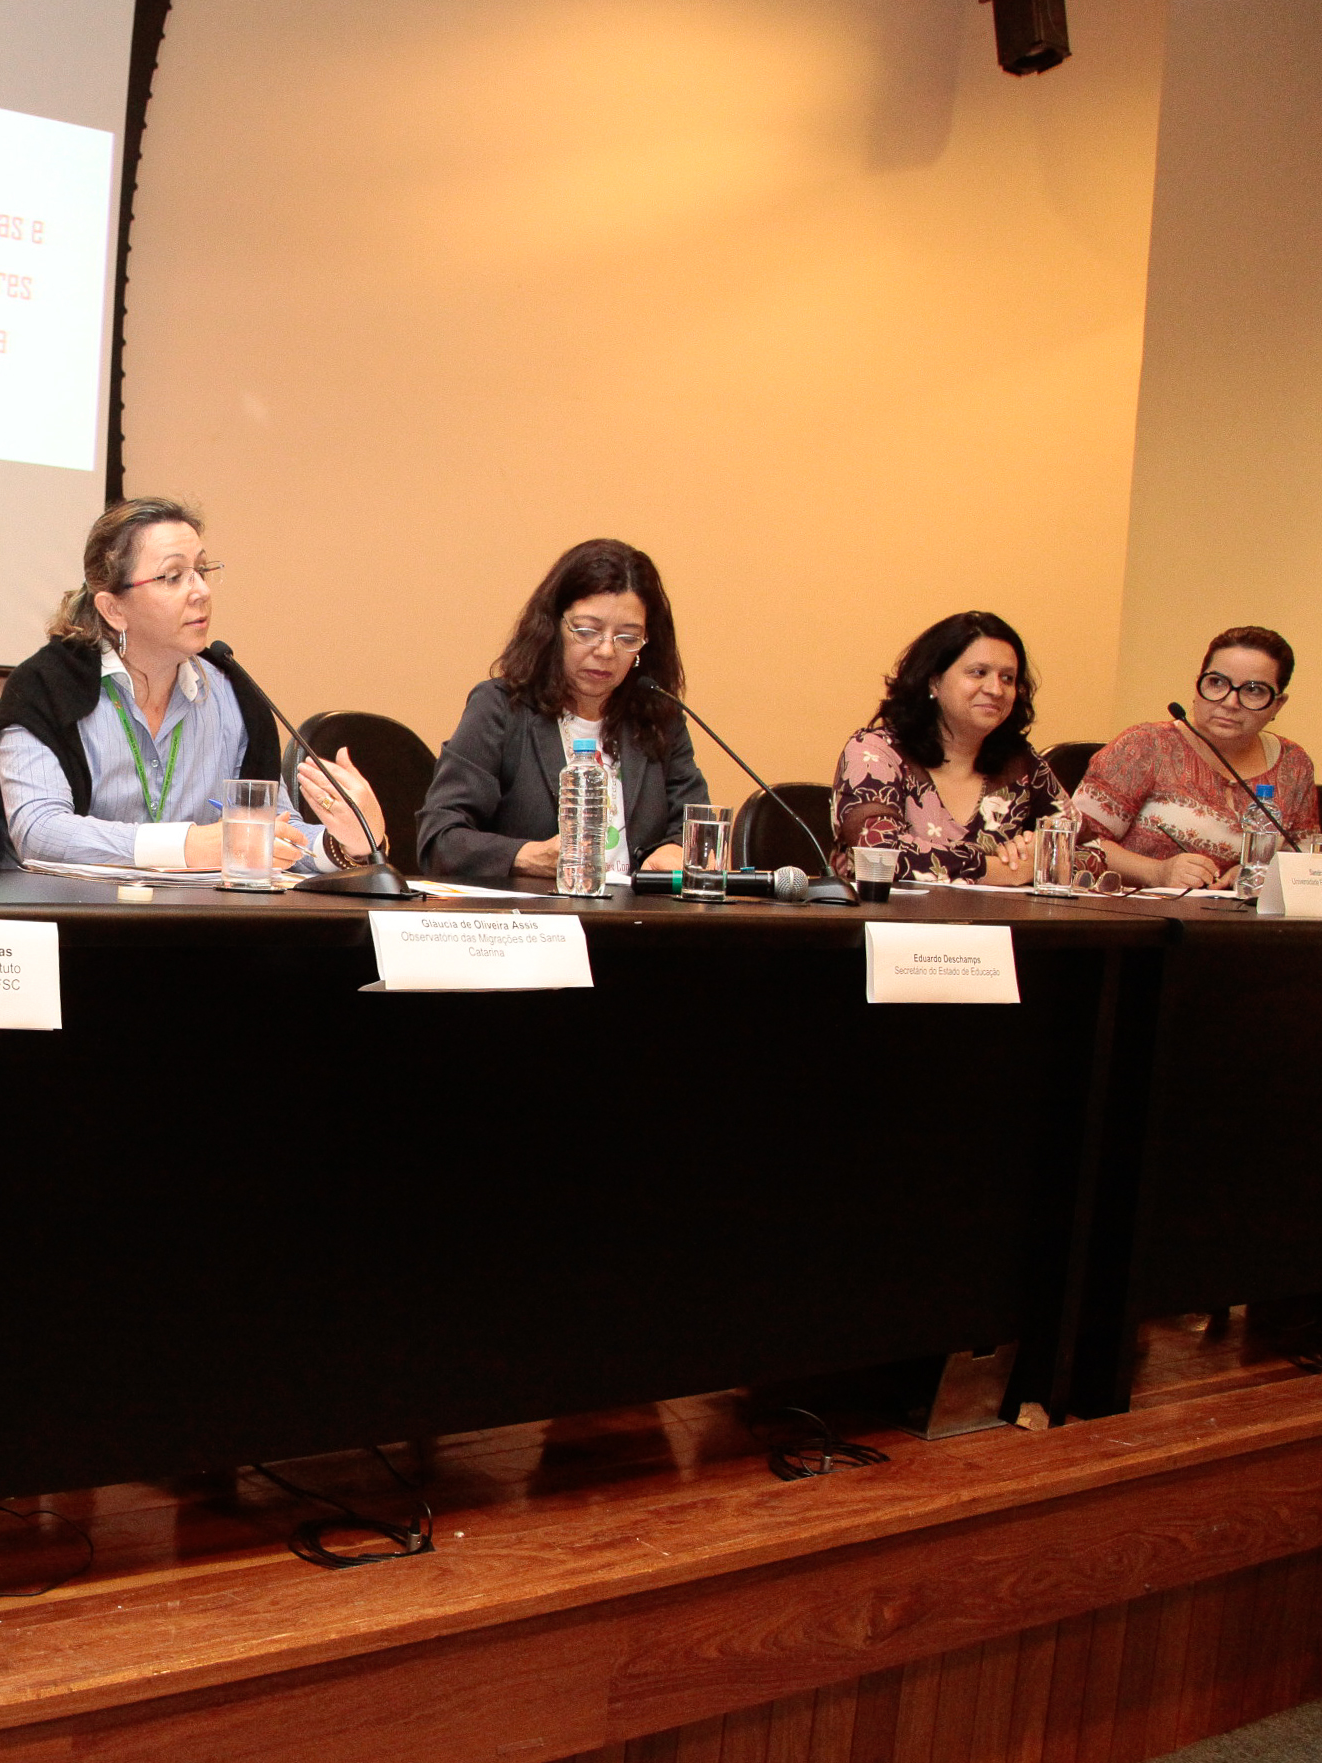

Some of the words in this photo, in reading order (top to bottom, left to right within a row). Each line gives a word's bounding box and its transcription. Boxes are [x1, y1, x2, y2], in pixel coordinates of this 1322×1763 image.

[31, 217, 46, 246] e
[460, 920, 472, 930] de
[473, 920, 509, 931] Oliveira
[511, 921, 539, 930] Assis
[400, 931, 459, 943] Observatório
[460, 933, 477, 943] das
[478, 933, 524, 946] Migrações
[526, 933, 538, 943] de
[539, 933, 566, 944] Santa
[468, 946, 505, 958] Catarina
[913, 954, 942, 964] Eduardo
[943, 954, 981, 966] Deschamps
[894, 965, 927, 976] Secretário
[938, 967, 960, 977] Estado
[971, 967, 1001, 979] Educação
